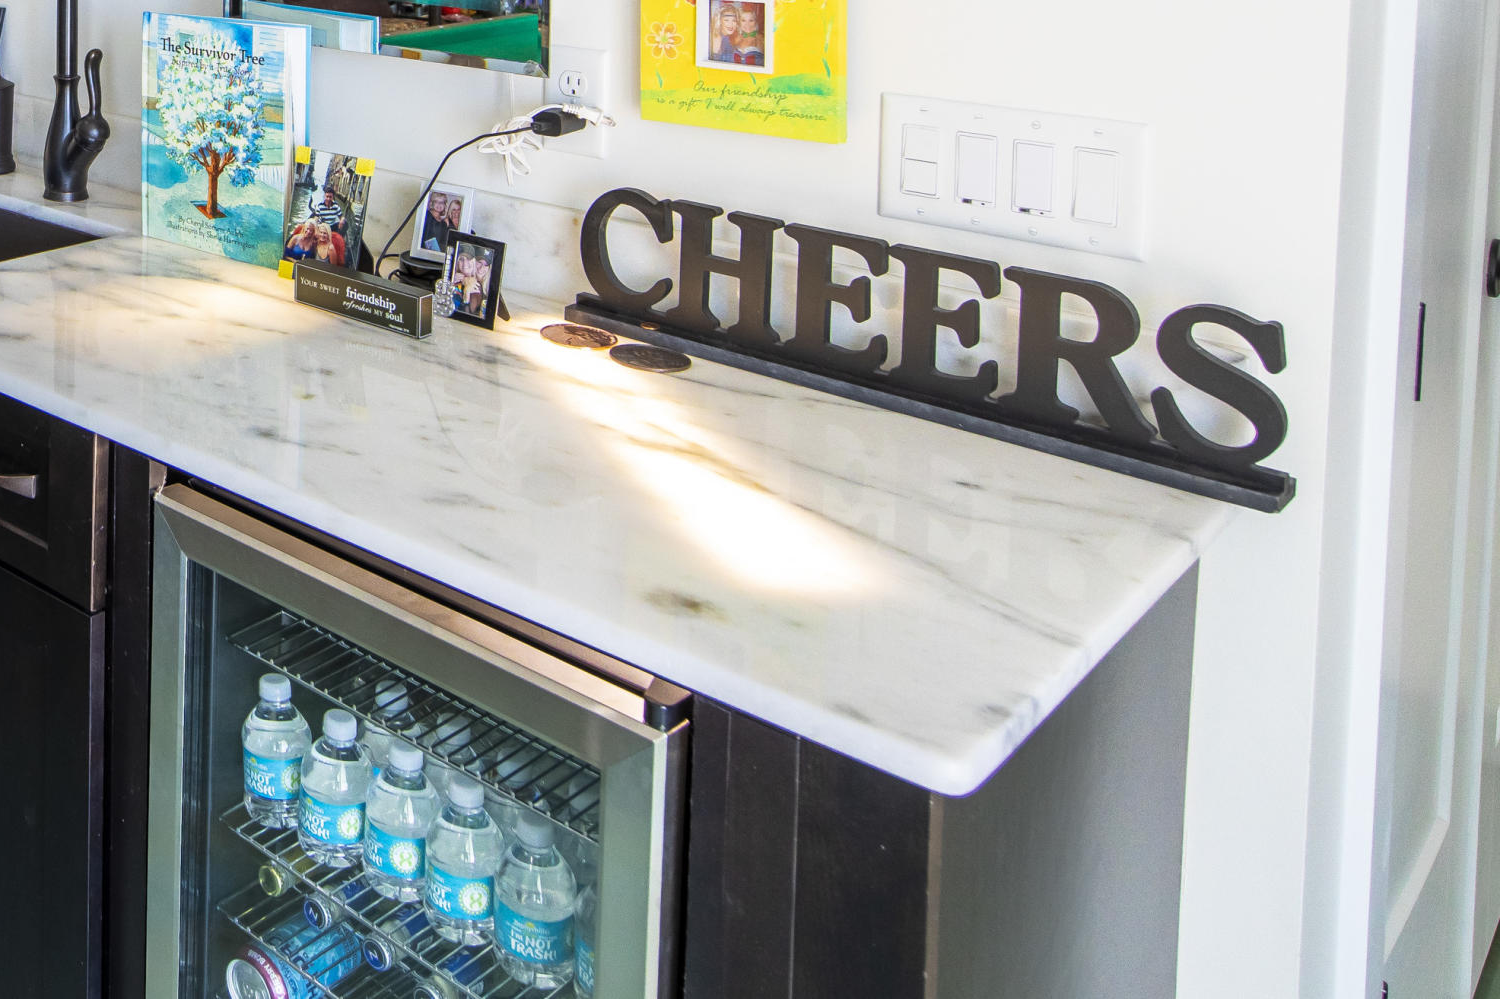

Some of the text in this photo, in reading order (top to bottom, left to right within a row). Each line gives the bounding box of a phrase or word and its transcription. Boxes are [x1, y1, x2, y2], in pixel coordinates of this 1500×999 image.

[160, 36, 265, 66] The Survivor Tree
[693, 80, 788, 104] Our friendship
[678, 98, 701, 112] gift
[714, 101, 736, 112] will
[738, 101, 777, 121] always
[300, 276, 397, 313] YOUR SWEET friendship
[374, 308, 384, 318] MY
[579, 187, 1288, 466] CHEERS
[508, 934, 557, 961] TRASH!
[525, 935, 558, 951] NOT
